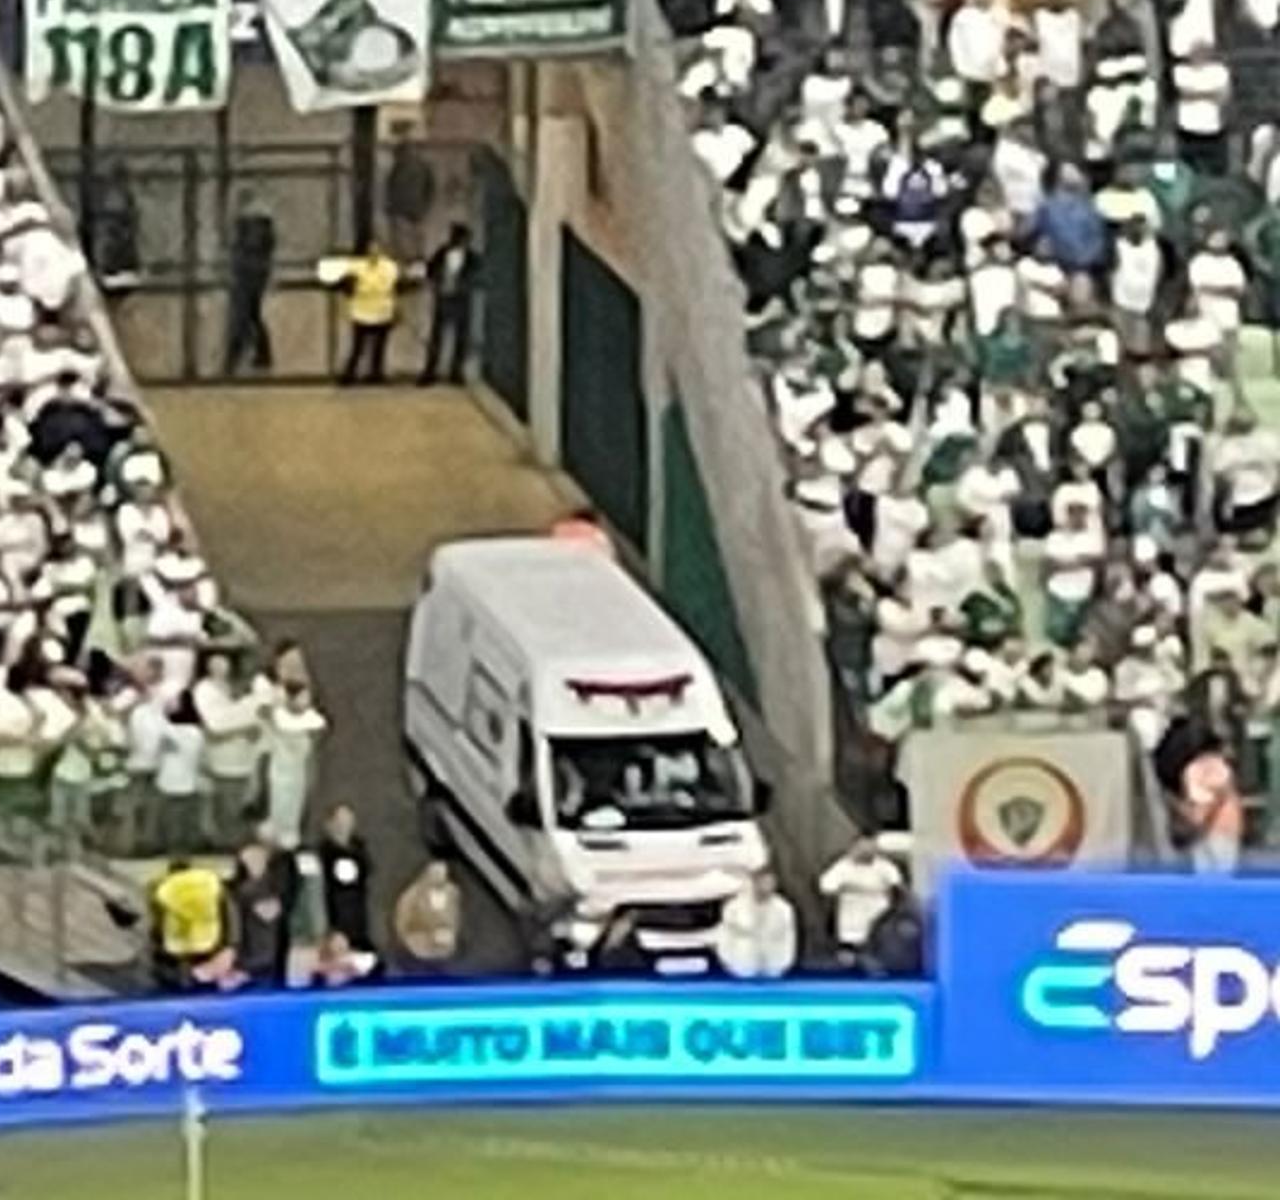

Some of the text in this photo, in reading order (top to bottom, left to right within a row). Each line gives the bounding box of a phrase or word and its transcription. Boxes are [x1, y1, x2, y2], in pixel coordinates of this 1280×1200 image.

[1023, 919, 1280, 1060] Esp
[68, 1020, 243, 1088] Sorte
[371, 1024, 529, 1066] MUITO
[542, 1018, 670, 1061] MAIS
[683, 1018, 787, 1064] QUE
[800, 1018, 900, 1061] BET
